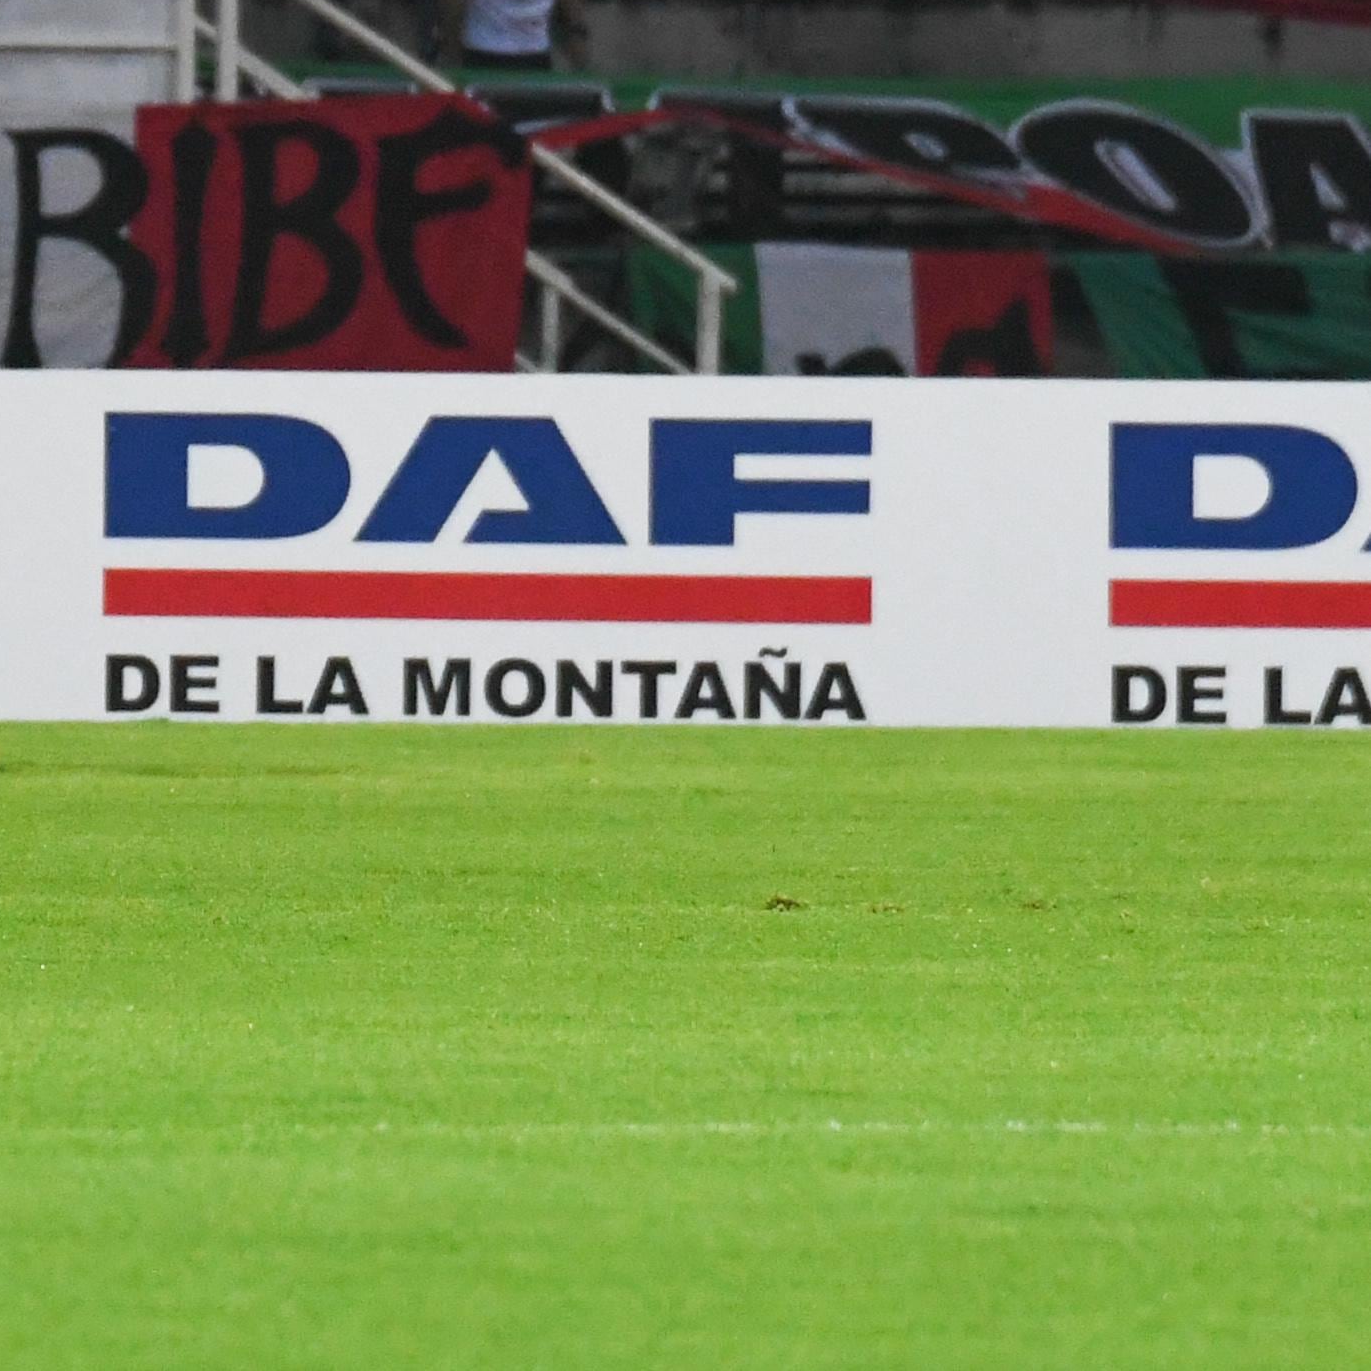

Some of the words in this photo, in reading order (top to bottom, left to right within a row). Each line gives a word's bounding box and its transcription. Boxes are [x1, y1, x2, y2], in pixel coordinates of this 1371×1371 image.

[104, 411, 873, 547] DAF
[1109, 422, 1371, 552] D
[105, 653, 221, 714] DE
[255, 655, 370, 716] LA
[403, 646, 867, 722] MONTAÑA
[1111, 664, 1228, 724] DE
[1263, 666, 1371, 725] LA
